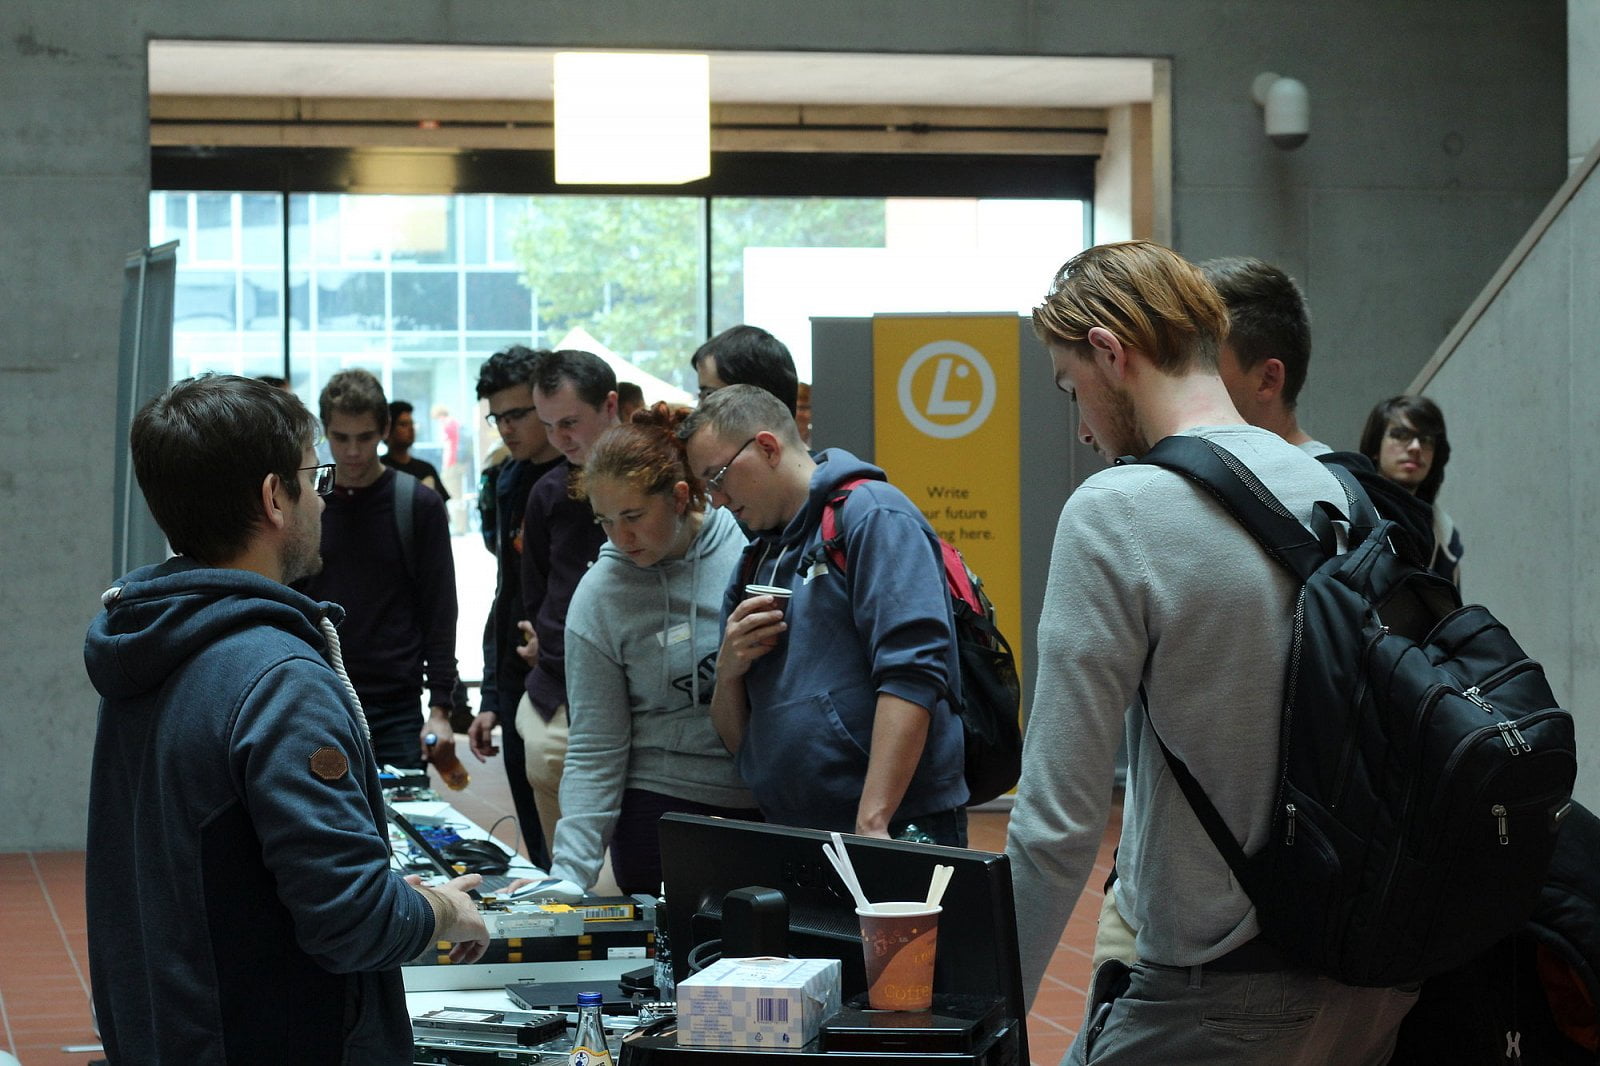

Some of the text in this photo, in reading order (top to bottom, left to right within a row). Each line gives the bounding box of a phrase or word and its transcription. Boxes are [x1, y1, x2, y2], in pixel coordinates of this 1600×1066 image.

[926, 486, 969, 499] Write
[945, 506, 987, 519] future
[959, 527, 995, 540] here.
